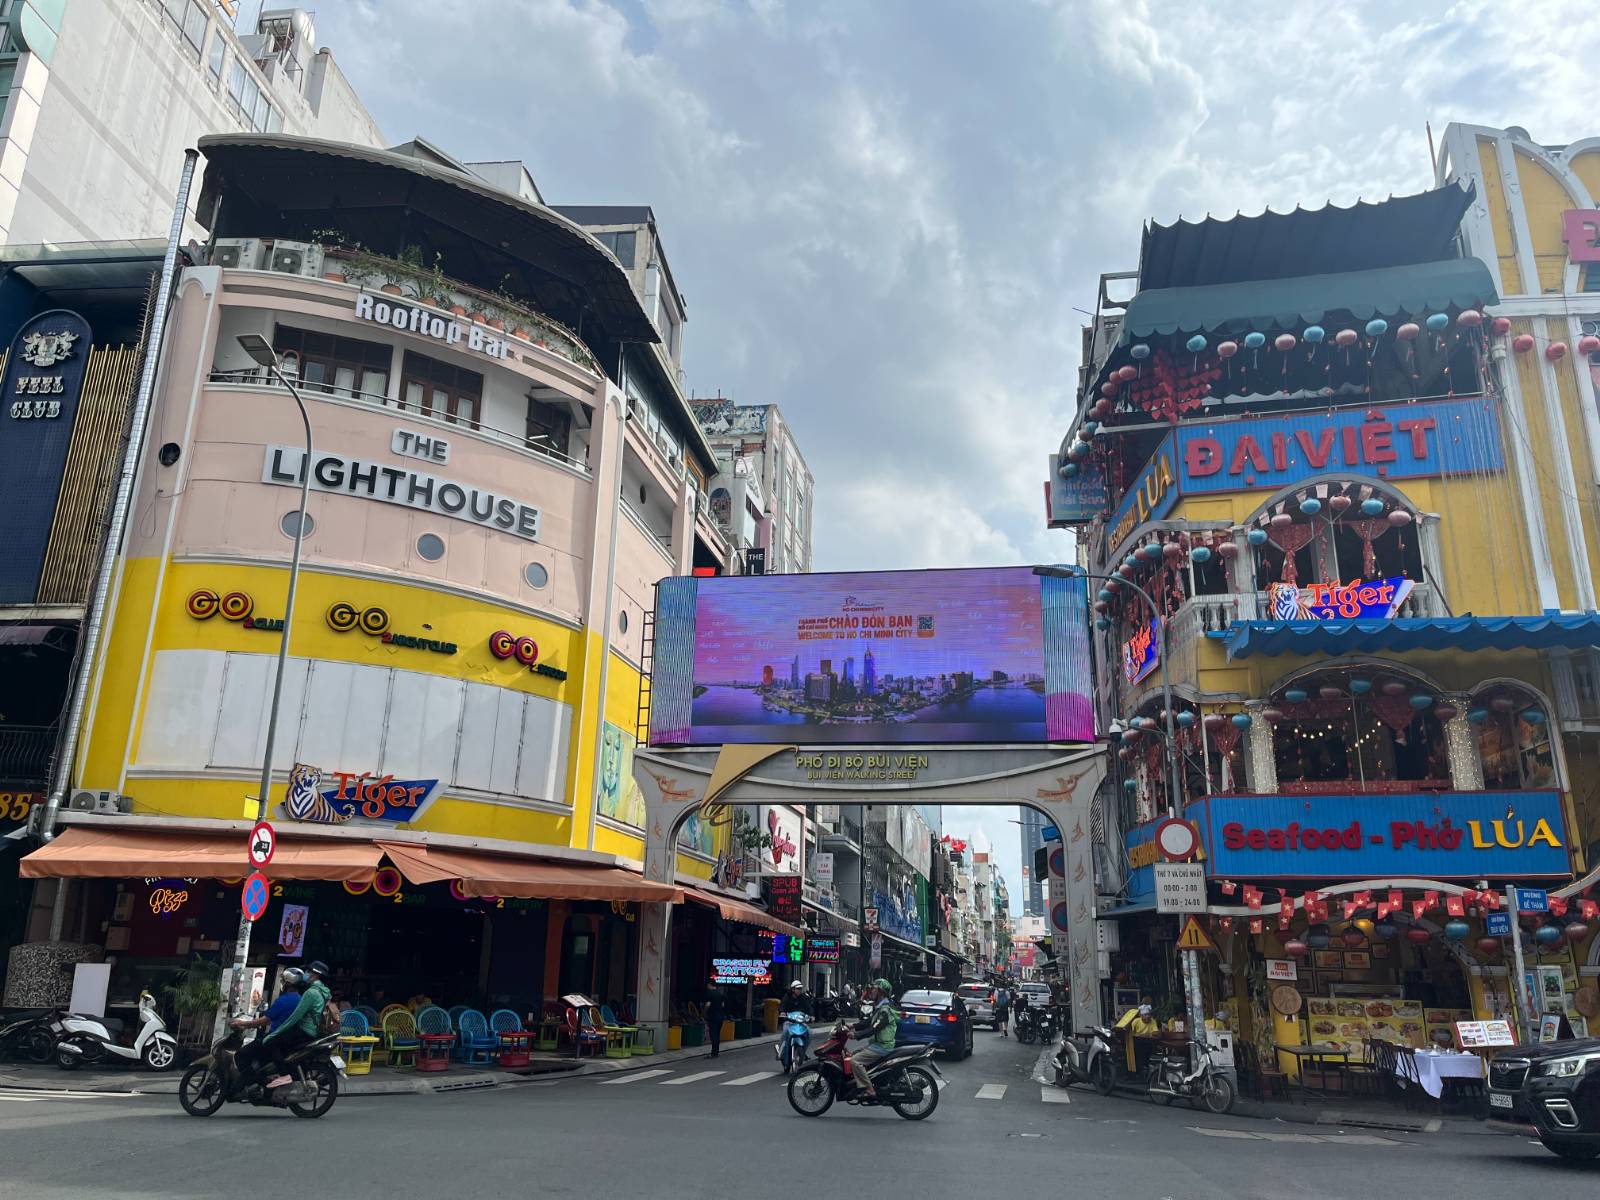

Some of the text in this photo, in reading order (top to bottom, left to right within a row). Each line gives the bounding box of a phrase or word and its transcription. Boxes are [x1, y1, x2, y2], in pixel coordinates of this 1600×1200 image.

[355, 293, 511, 360] Rooftop Bar
[15, 376, 64, 394] FEEL
[10, 401, 61, 418] CLUB
[399, 432, 448, 460] THE
[271, 449, 538, 536] LIGHTHOUSE
[185, 588, 253, 622] GO
[1306, 578, 1394, 618] Tiger
[326, 601, 391, 636] GO
[829, 614, 859, 629] CHÀO
[889, 614, 913, 629] BẠN
[798, 628, 913, 640] WELCOME TO HO CHI MINH CITY
[489, 630, 539, 666] GO
[796, 752, 928, 770] PHỐ ĐI BỘ BÙI VIỆN
[807, 771, 918, 779] BUI VIEN WALKING STREET
[332, 771, 425, 818] Tiger
[1222, 820, 1362, 850] Seafood
[1391, 817, 1464, 850] Phở
[1467, 805, 1563, 849] LÚA
[150, 888, 188, 914] Pizza
[753, 959, 771, 967] FLY
[808, 951, 839, 960] TATTOO
[716, 966, 767, 976] TATTOO
